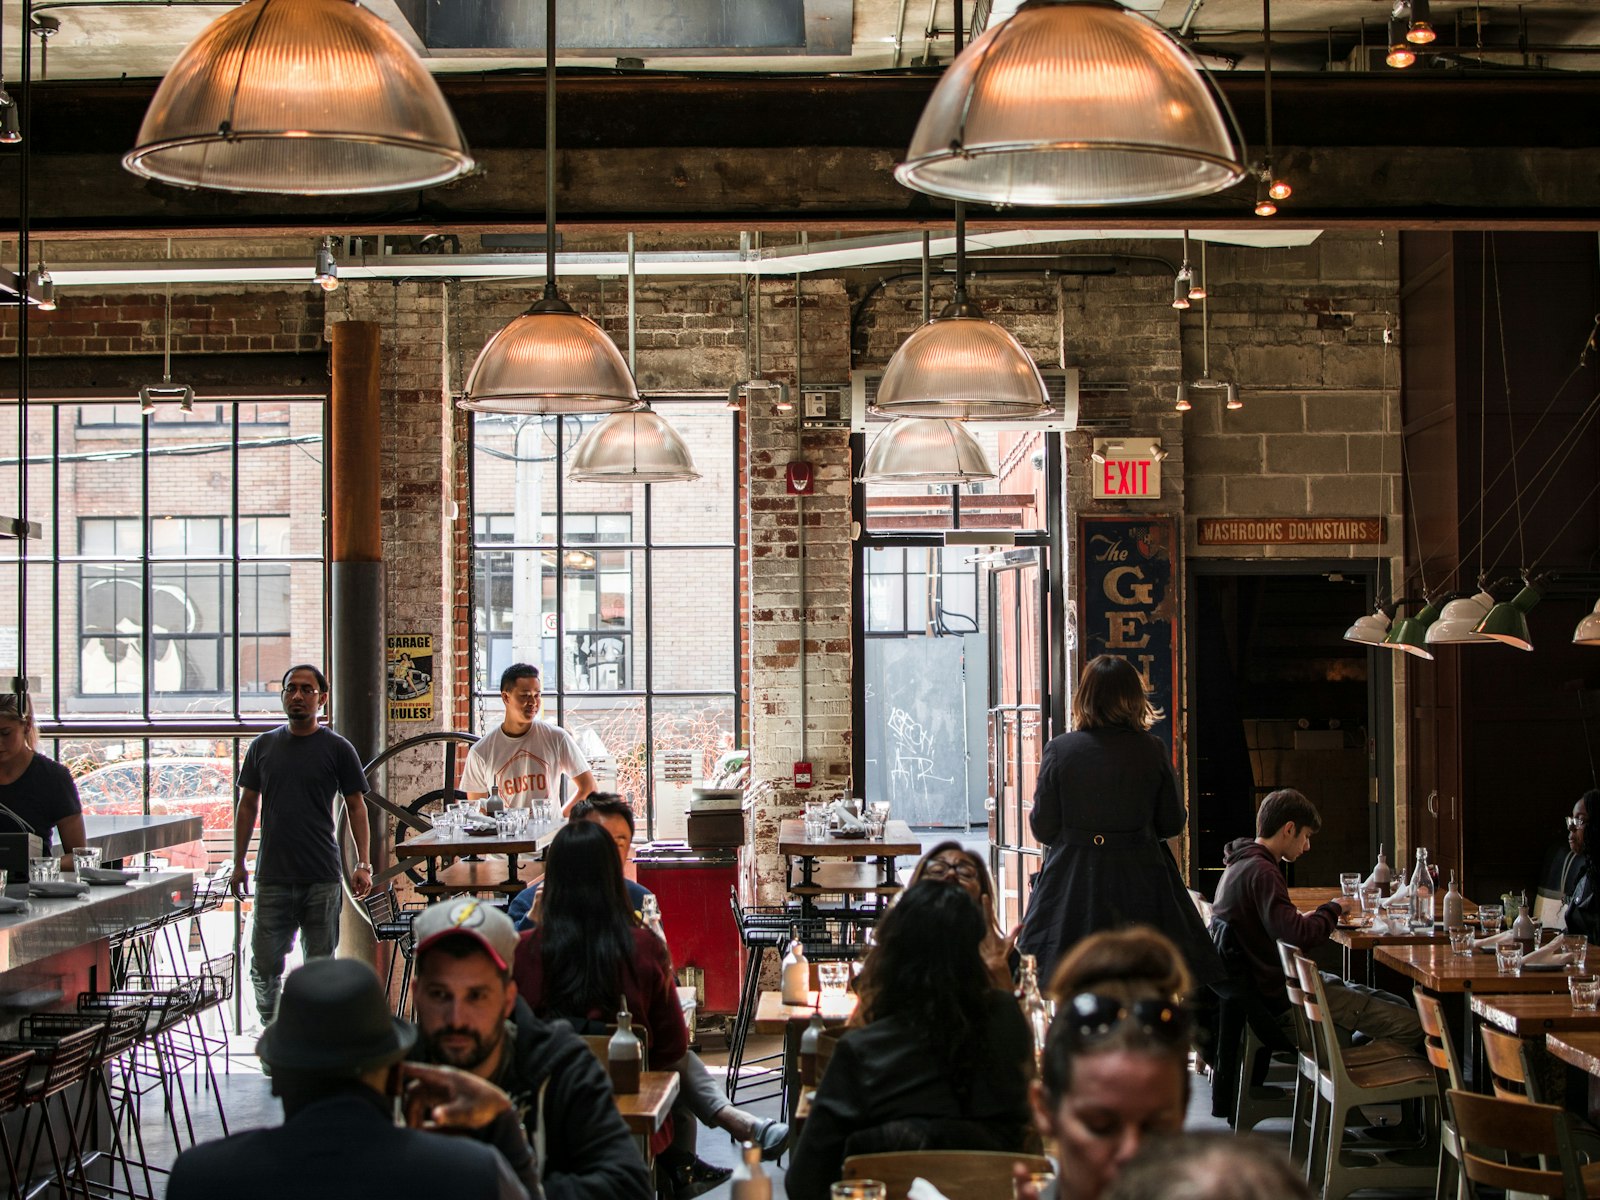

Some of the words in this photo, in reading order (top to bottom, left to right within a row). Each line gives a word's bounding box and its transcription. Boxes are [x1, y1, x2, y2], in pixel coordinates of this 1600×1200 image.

[1104, 461, 1150, 495] EXIT
[1204, 522, 1283, 541] WASHROOMS
[1288, 521, 1367, 540] DOWNSTAIRS
[1090, 534, 1129, 562] The
[388, 636, 431, 649] GARAGE
[390, 707, 432, 719] RULES!
[504, 773, 547, 796] GUSTO
